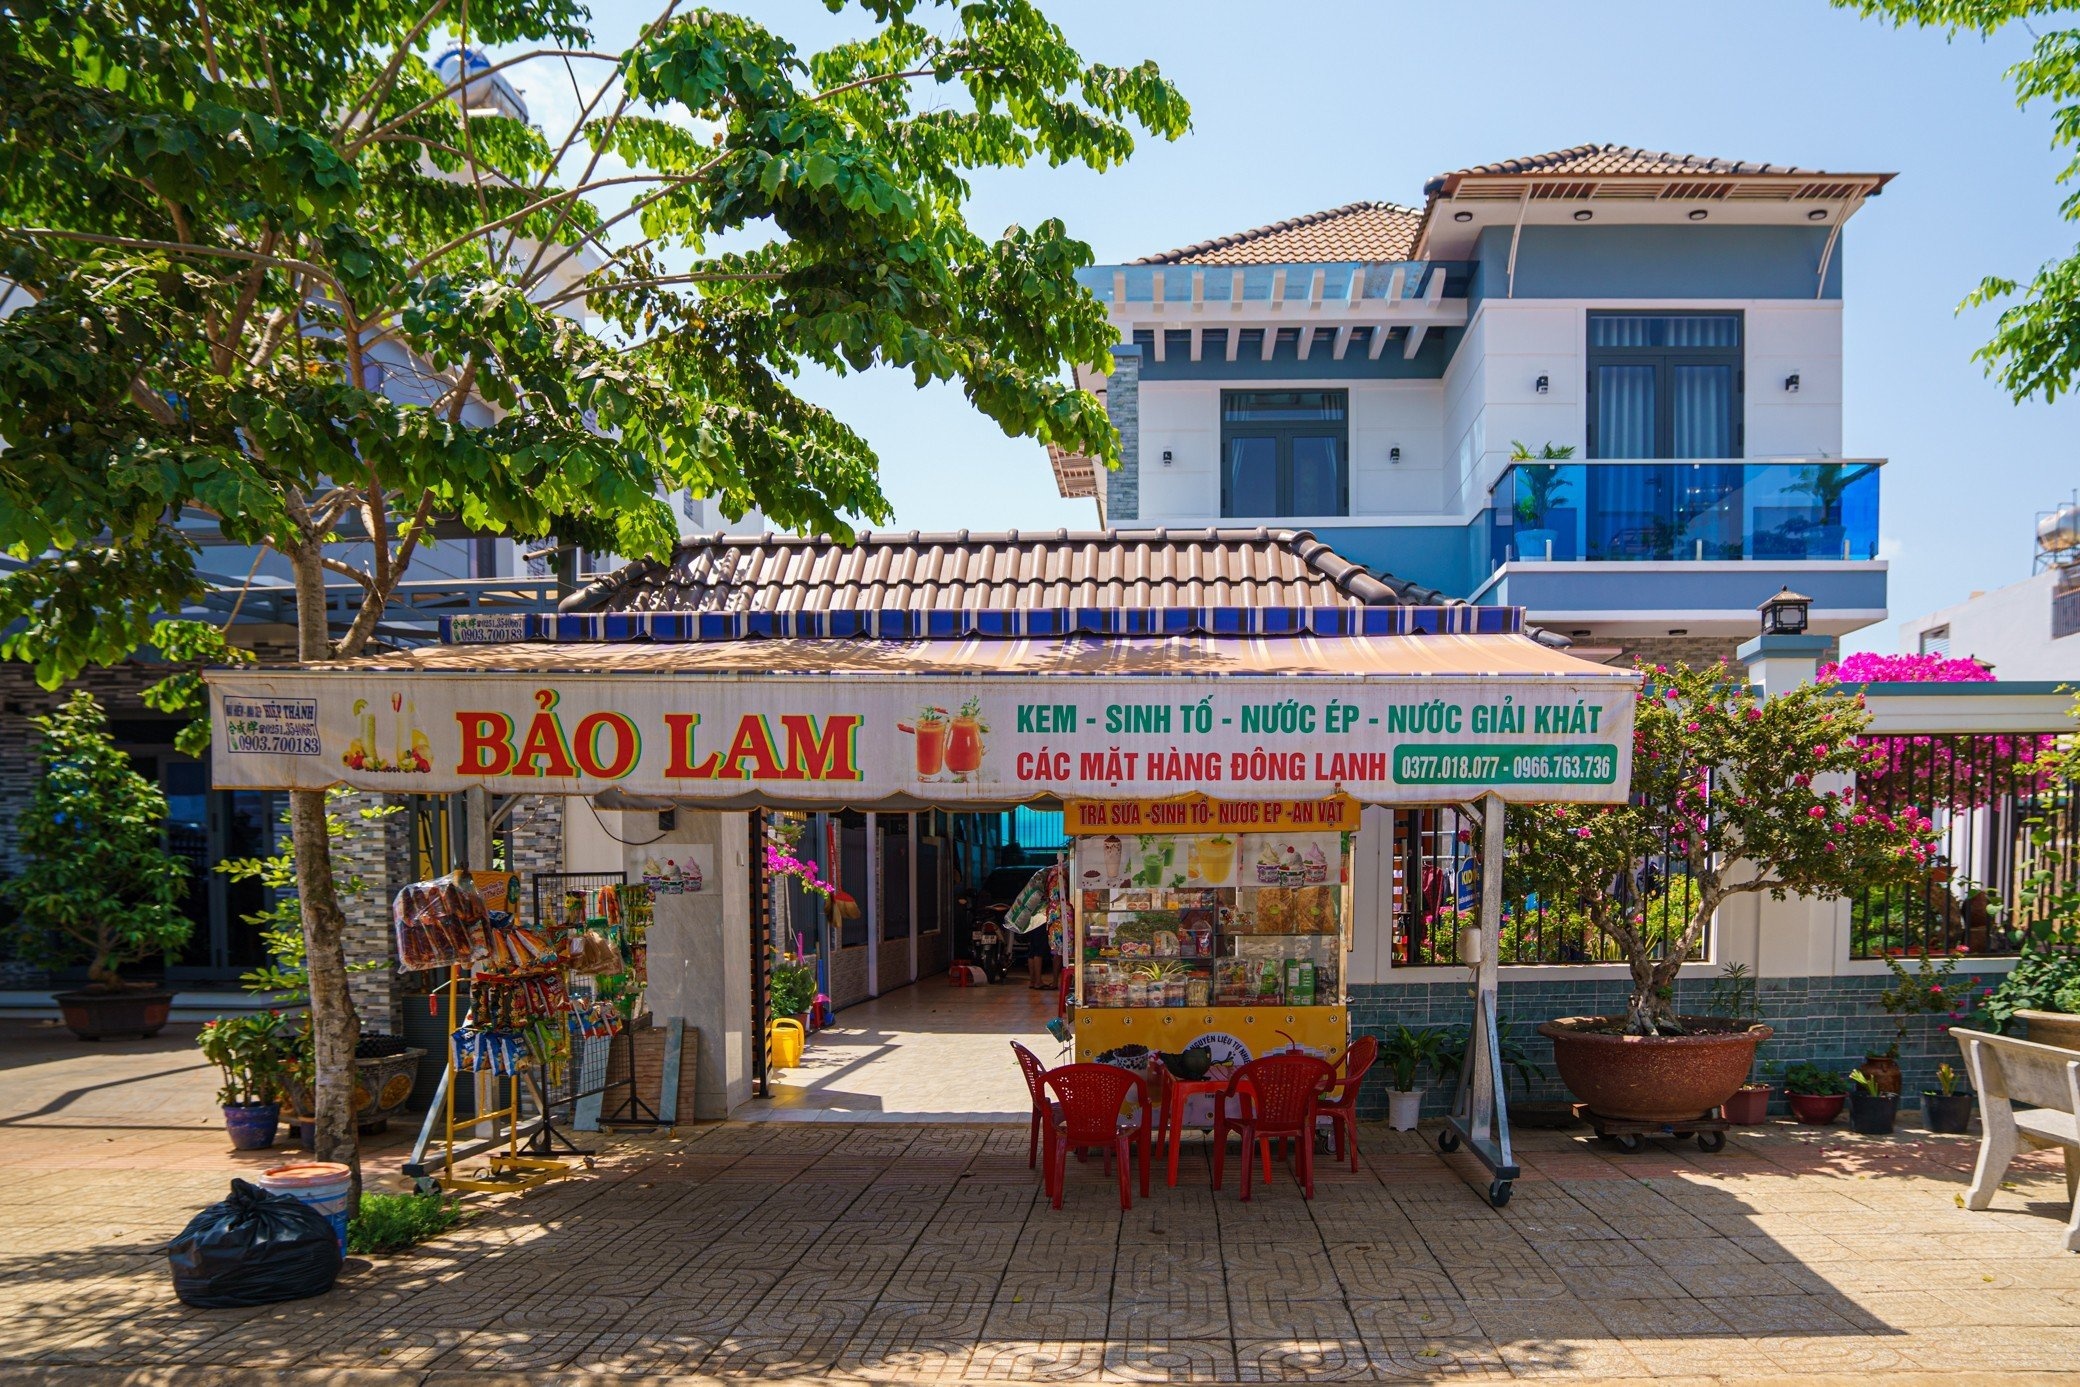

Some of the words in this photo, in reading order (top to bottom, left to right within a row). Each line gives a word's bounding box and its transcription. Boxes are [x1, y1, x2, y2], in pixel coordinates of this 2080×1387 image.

[461, 629, 523, 640] 0903.700183
[1017, 704, 1077, 733] KEM
[1105, 704, 1172, 734] SINH
[1180, 695, 1213, 734] TỐ
[1241, 699, 1316, 734] NƯỚC
[1325, 699, 1359, 734] ÉP
[1388, 699, 1462, 734] NƯỚC
[1472, 695, 1525, 734] GIẢI
[1534, 700, 1603, 734] KHÁT
[239, 735, 319, 753] 0903.700183
[456, 688, 640, 780] BẢO
[664, 713, 862, 781] LAM
[1017, 747, 1070, 781] CÁC
[1080, 747, 1138, 787] MẶT
[1147, 747, 1222, 781] HÀNG
[1231, 747, 1306, 781] ĐÔNG
[1315, 753, 1386, 788] LẠNH
[1402, 756, 1500, 778] 0377.018.077
[1513, 756, 1610, 778] 0966.763.736
